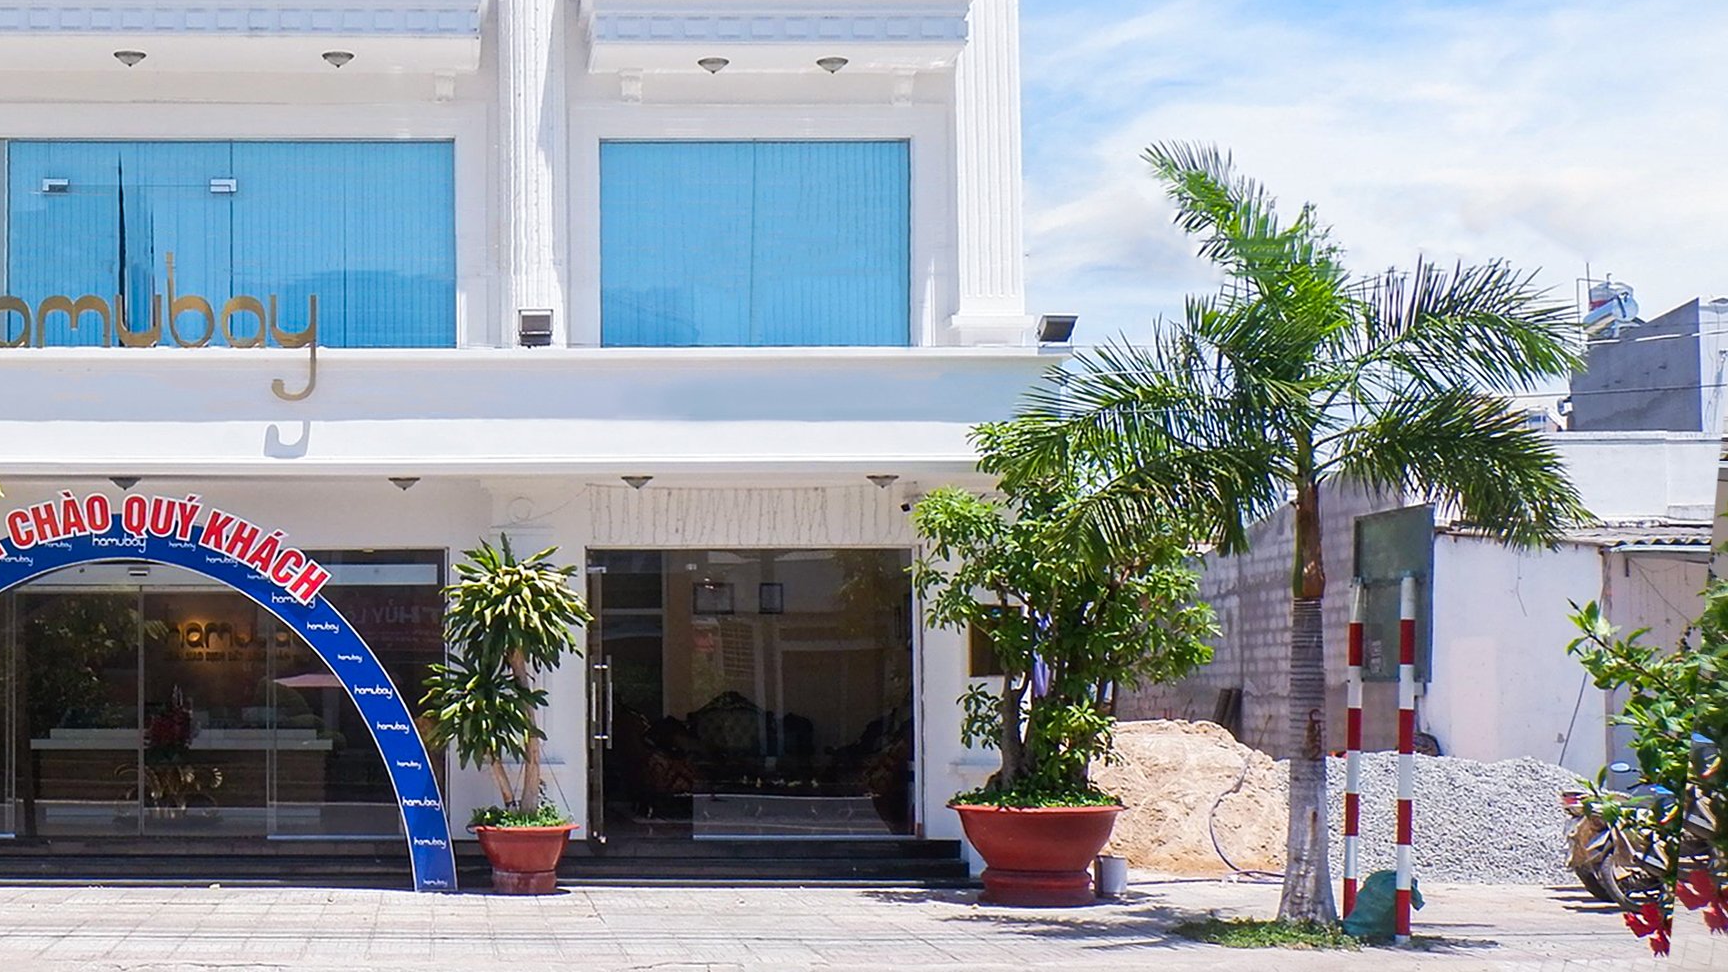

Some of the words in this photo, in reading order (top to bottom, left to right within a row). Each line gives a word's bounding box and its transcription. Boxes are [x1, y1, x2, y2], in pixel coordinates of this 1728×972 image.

[7, 489, 112, 549] CHÀO
[122, 493, 204, 542] QUÝ
[200, 508, 333, 606] KHÁCH
[92, 533, 147, 553] hamubay
[354, 684, 393, 700] hamubay
[377, 721, 410, 734] hamubay
[402, 796, 441, 811] hamubay
[413, 836, 447, 850] hamubay
